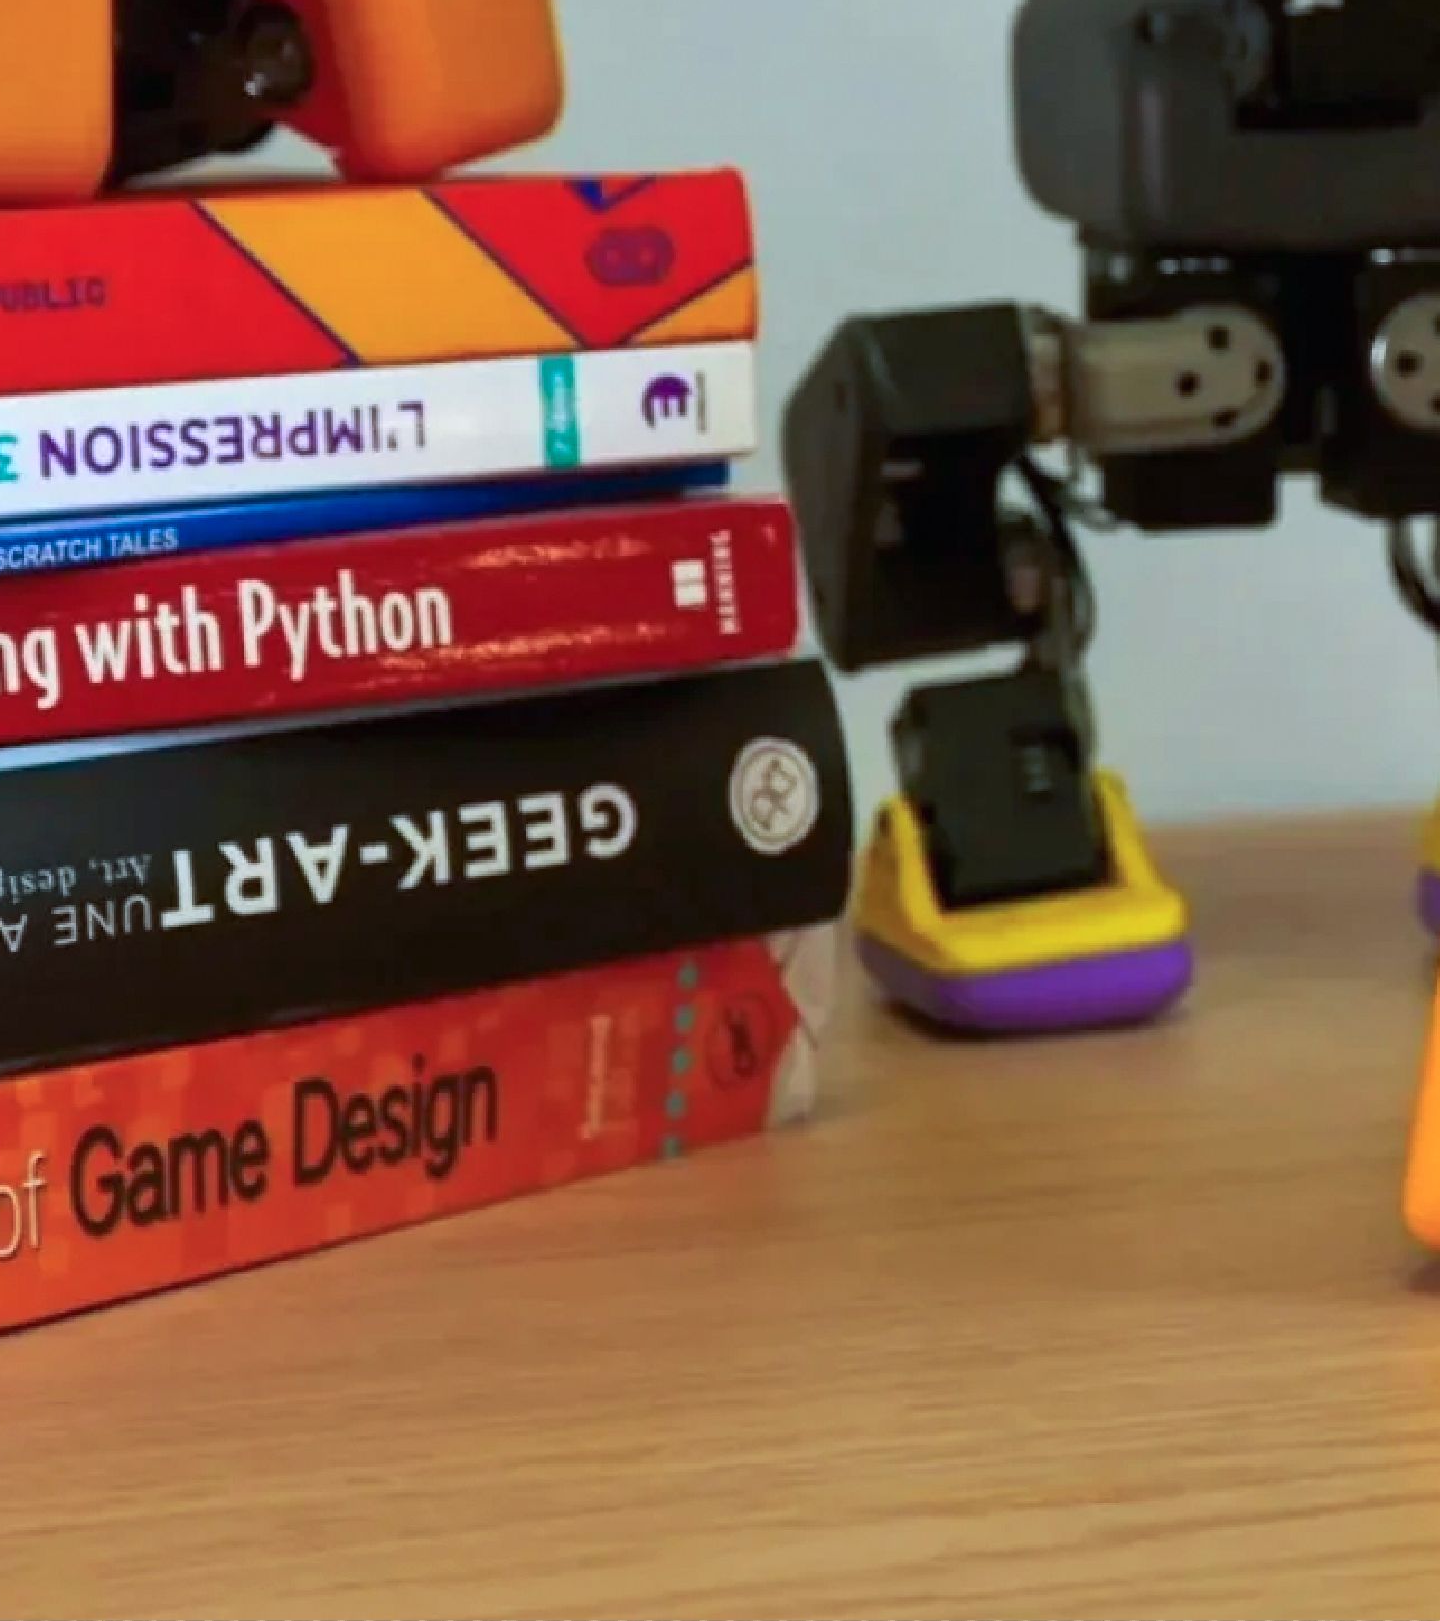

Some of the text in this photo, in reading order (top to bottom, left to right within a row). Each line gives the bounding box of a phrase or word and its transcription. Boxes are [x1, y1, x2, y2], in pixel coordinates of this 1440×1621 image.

[39, 400, 425, 478] L'IMPRESSION
[108, 527, 179, 556] TALES
[75, 585, 222, 684] with
[238, 569, 452, 680] Python
[88, 853, 153, 885] Art,
[160, 782, 639, 928] GEEK-ART
[51, 893, 153, 946] UNE
[71, 1118, 273, 1237] Game
[290, 1055, 499, 1188] Design
